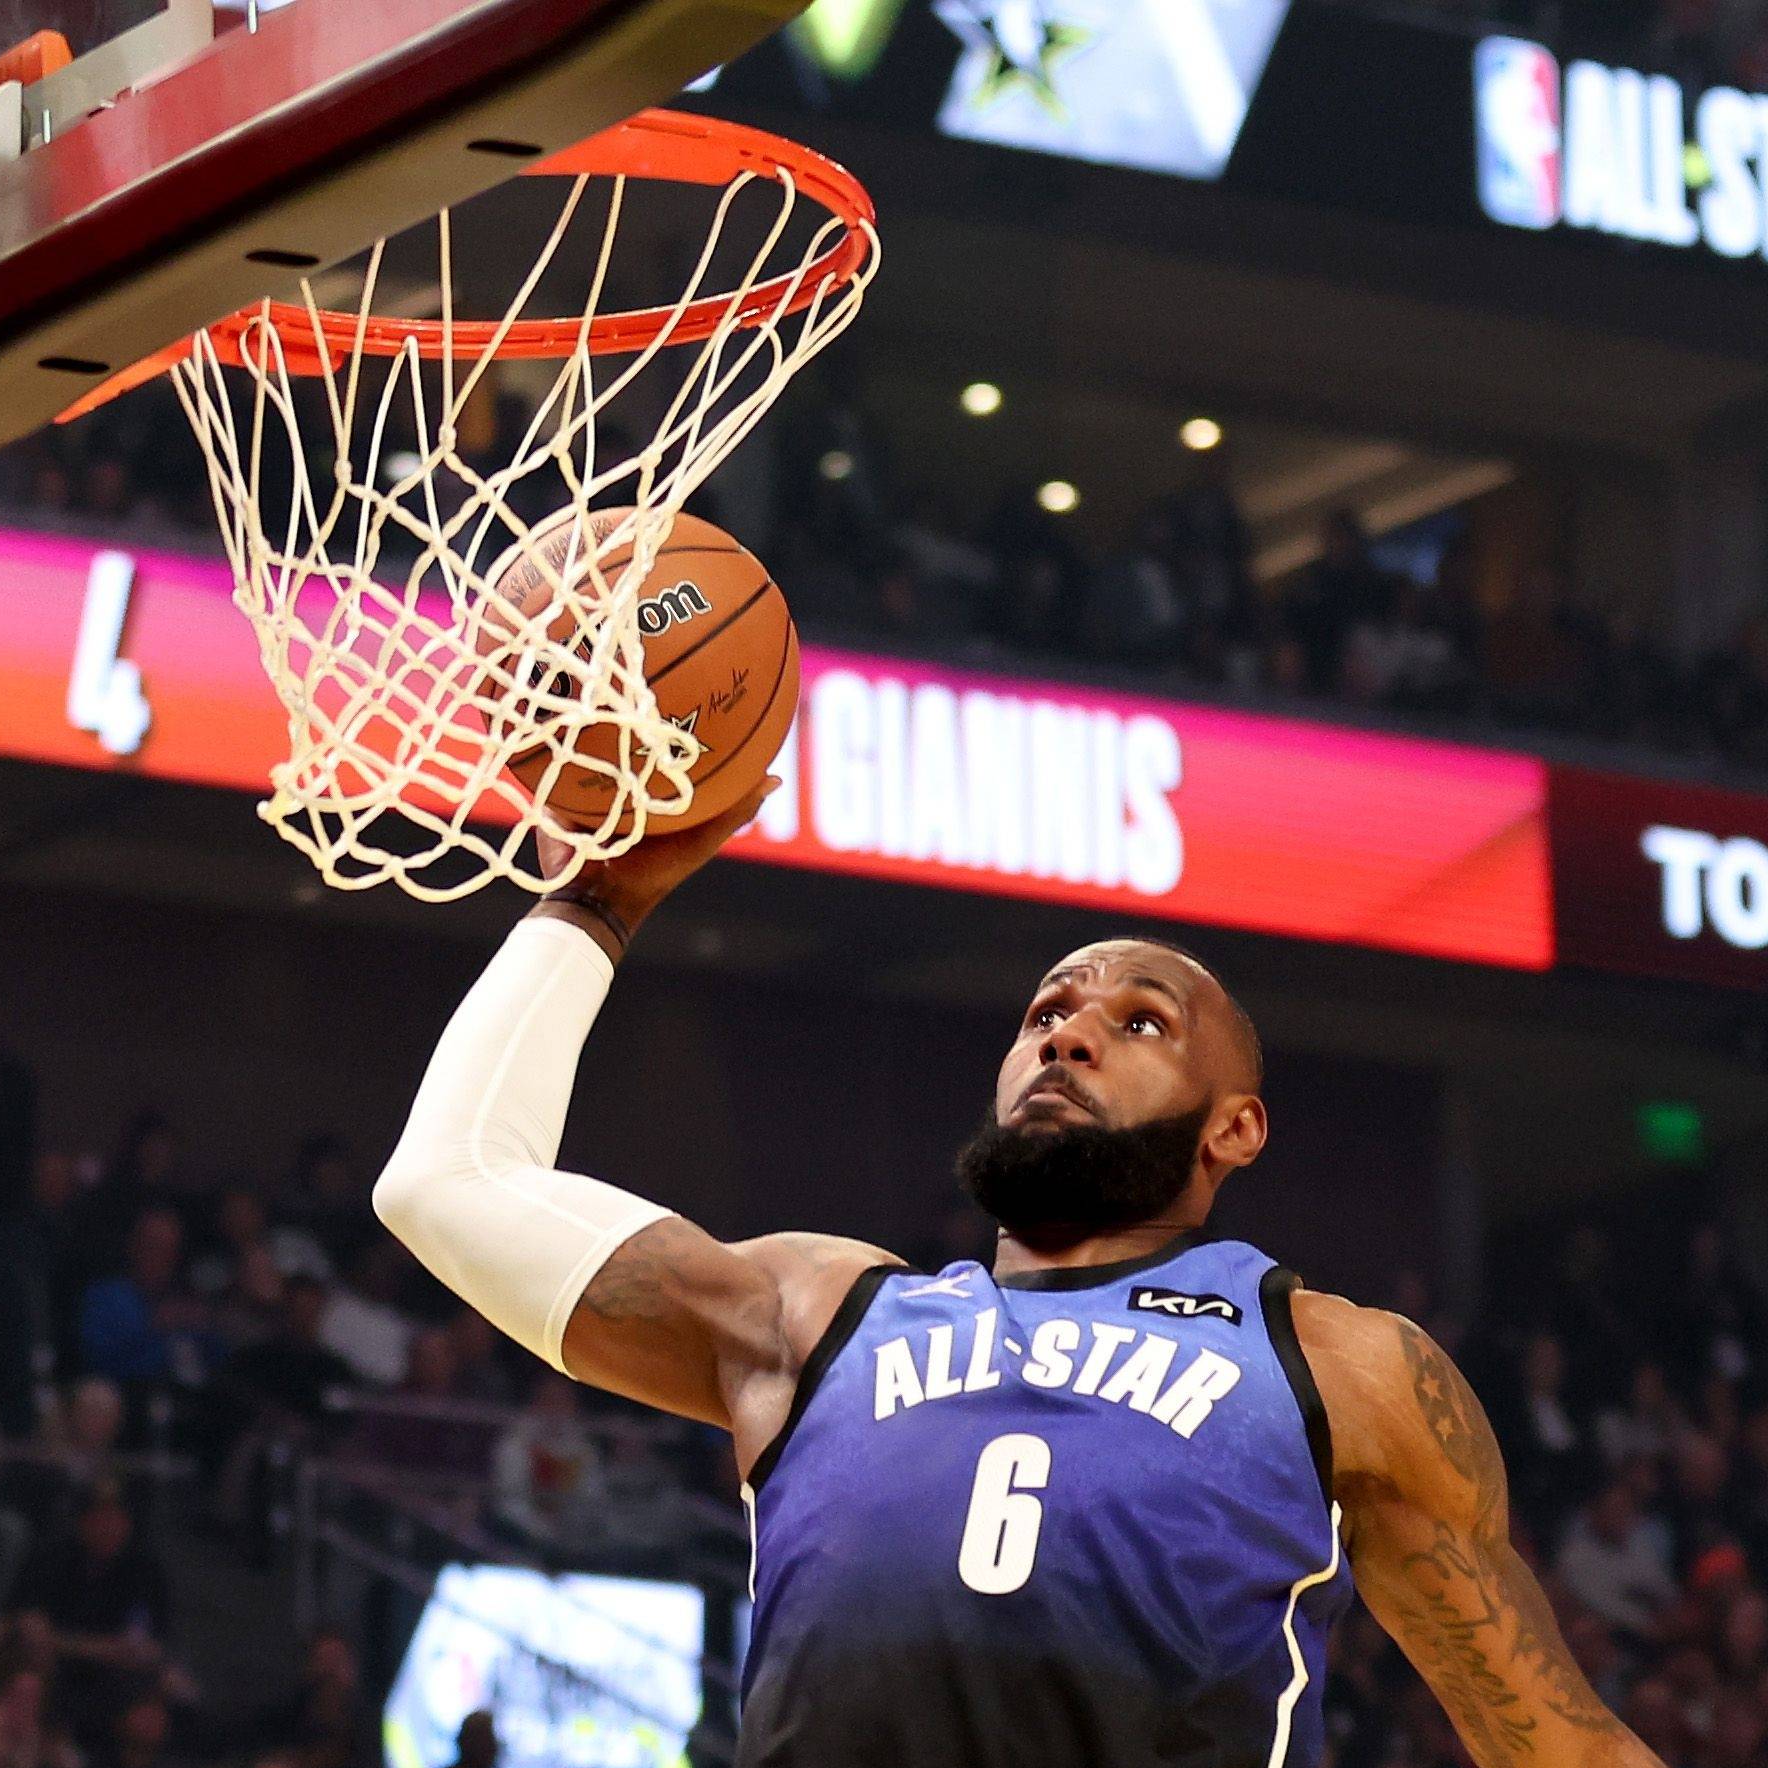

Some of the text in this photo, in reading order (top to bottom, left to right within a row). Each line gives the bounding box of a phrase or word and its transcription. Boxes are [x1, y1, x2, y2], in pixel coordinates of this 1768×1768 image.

[67, 549, 152, 756] 4
[812, 671, 1184, 898] GIANNIS
[957, 1432, 1052, 1595] 6
